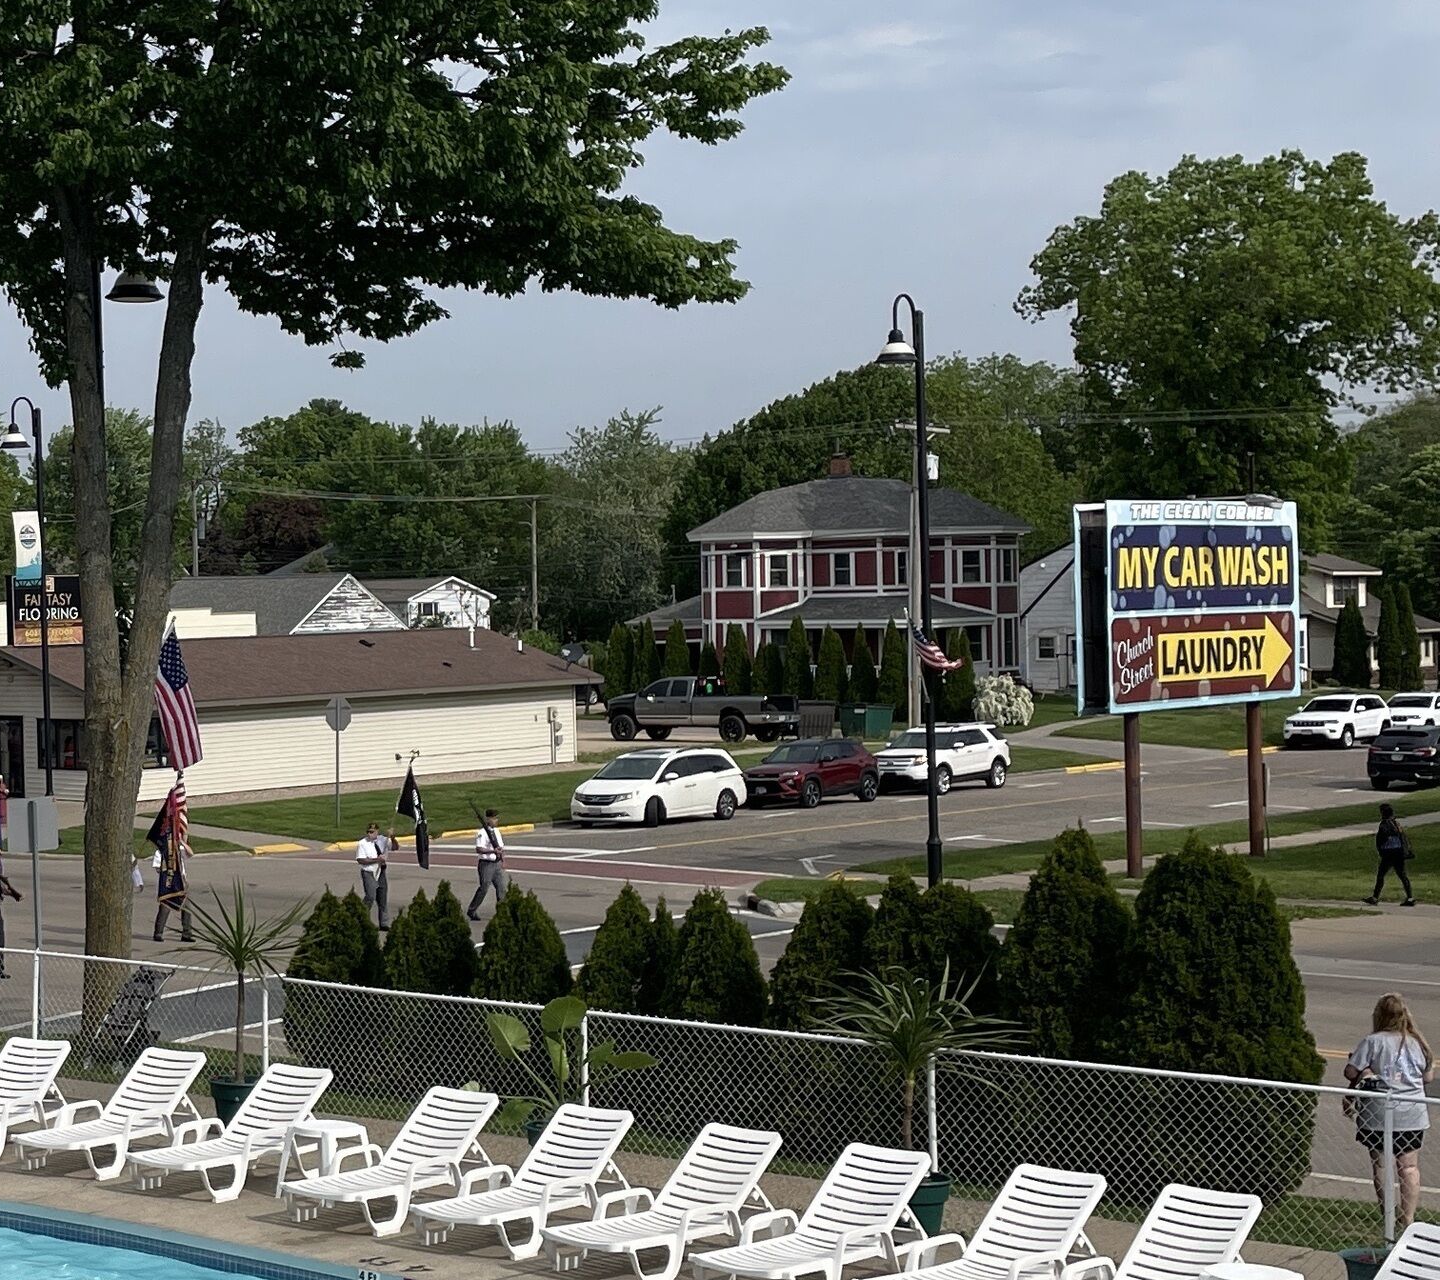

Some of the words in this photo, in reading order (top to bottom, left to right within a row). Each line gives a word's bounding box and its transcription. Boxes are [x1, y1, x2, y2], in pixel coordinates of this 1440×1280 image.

[1130, 503, 1160, 520] THE
[1163, 503, 1213, 520] CLEAN
[1118, 546, 1160, 589] MY
[1163, 545, 1215, 588] CAR
[1217, 545, 1289, 586] WASH
[1116, 626, 1154, 670] Church
[1162, 635, 1266, 676] LAUNDRY
[1120, 658, 1154, 695] Street
[359, 1271, 365, 1280] 4
